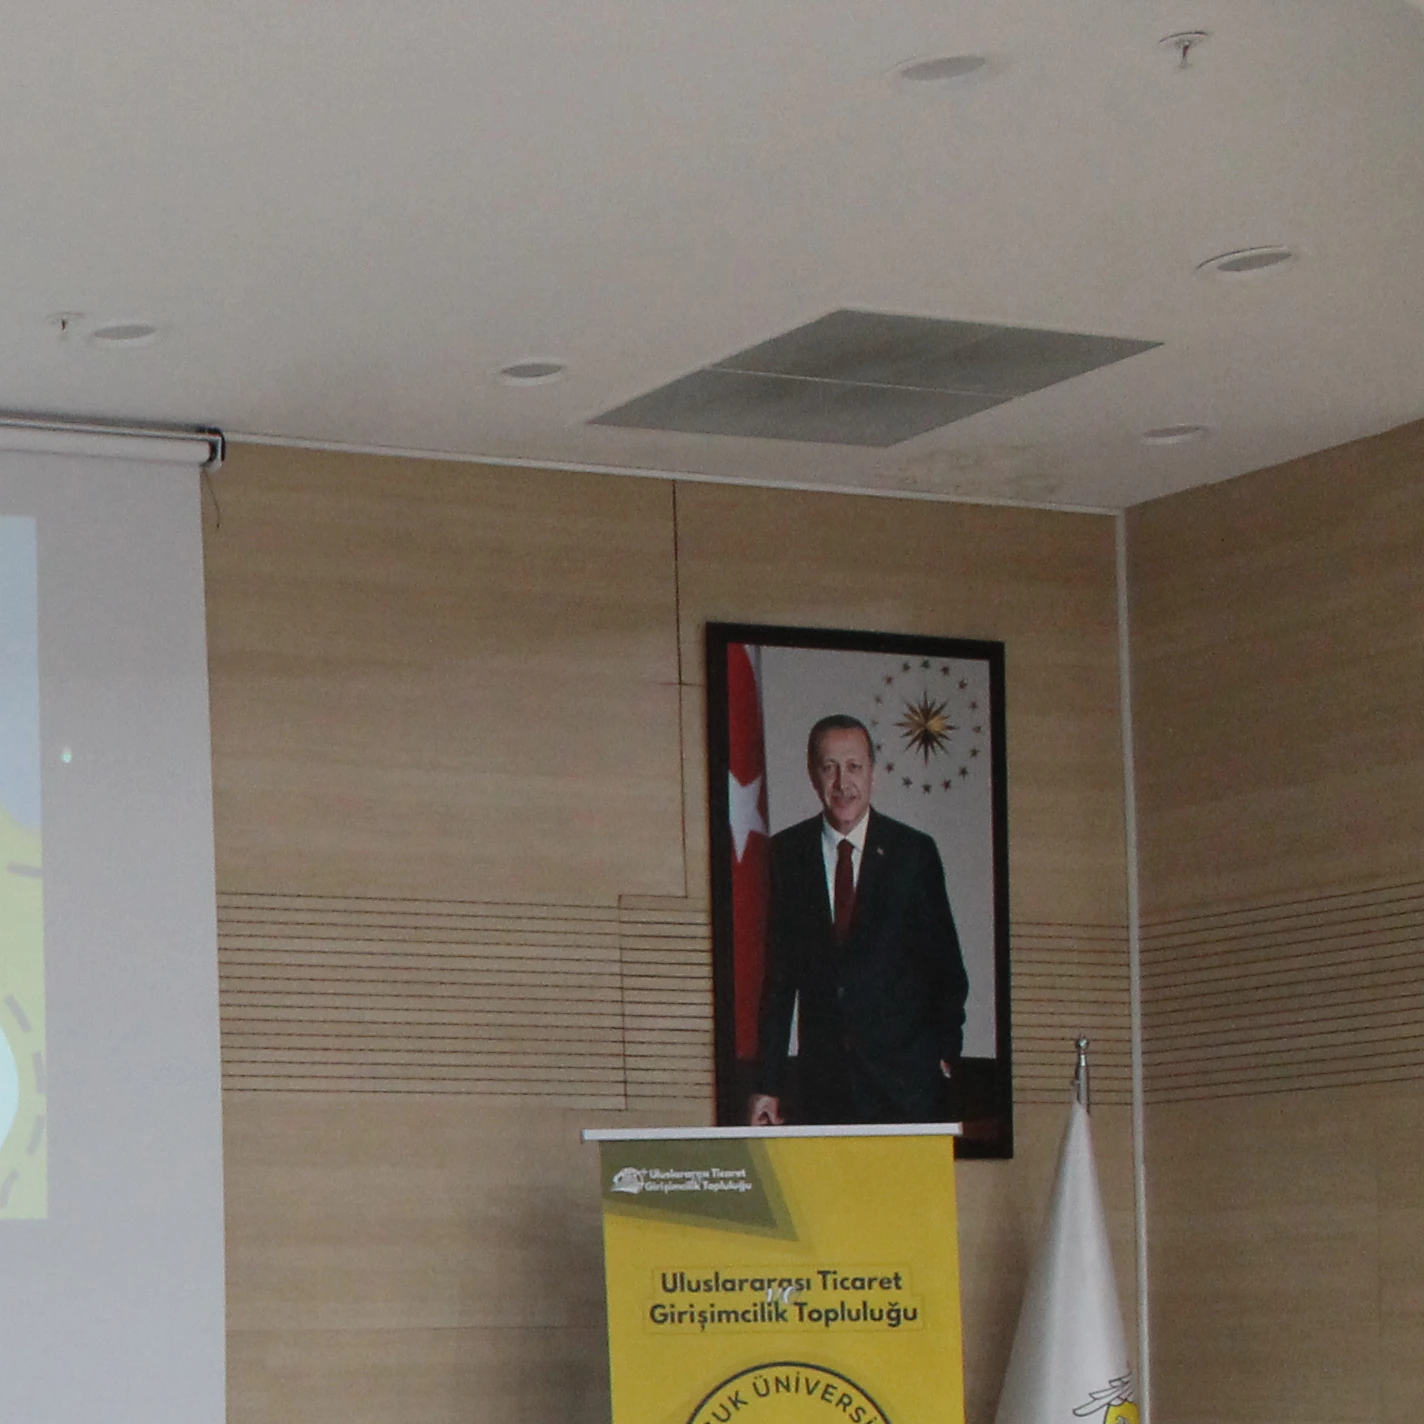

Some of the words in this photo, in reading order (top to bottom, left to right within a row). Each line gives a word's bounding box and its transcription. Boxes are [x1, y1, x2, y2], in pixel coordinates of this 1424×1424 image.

[661, 1271, 811, 1292] Uluslararası
[817, 1270, 902, 1291] Ticaret
[650, 1302, 788, 1330] Girişimcilik
[793, 1299, 918, 1328] Topluluğu
